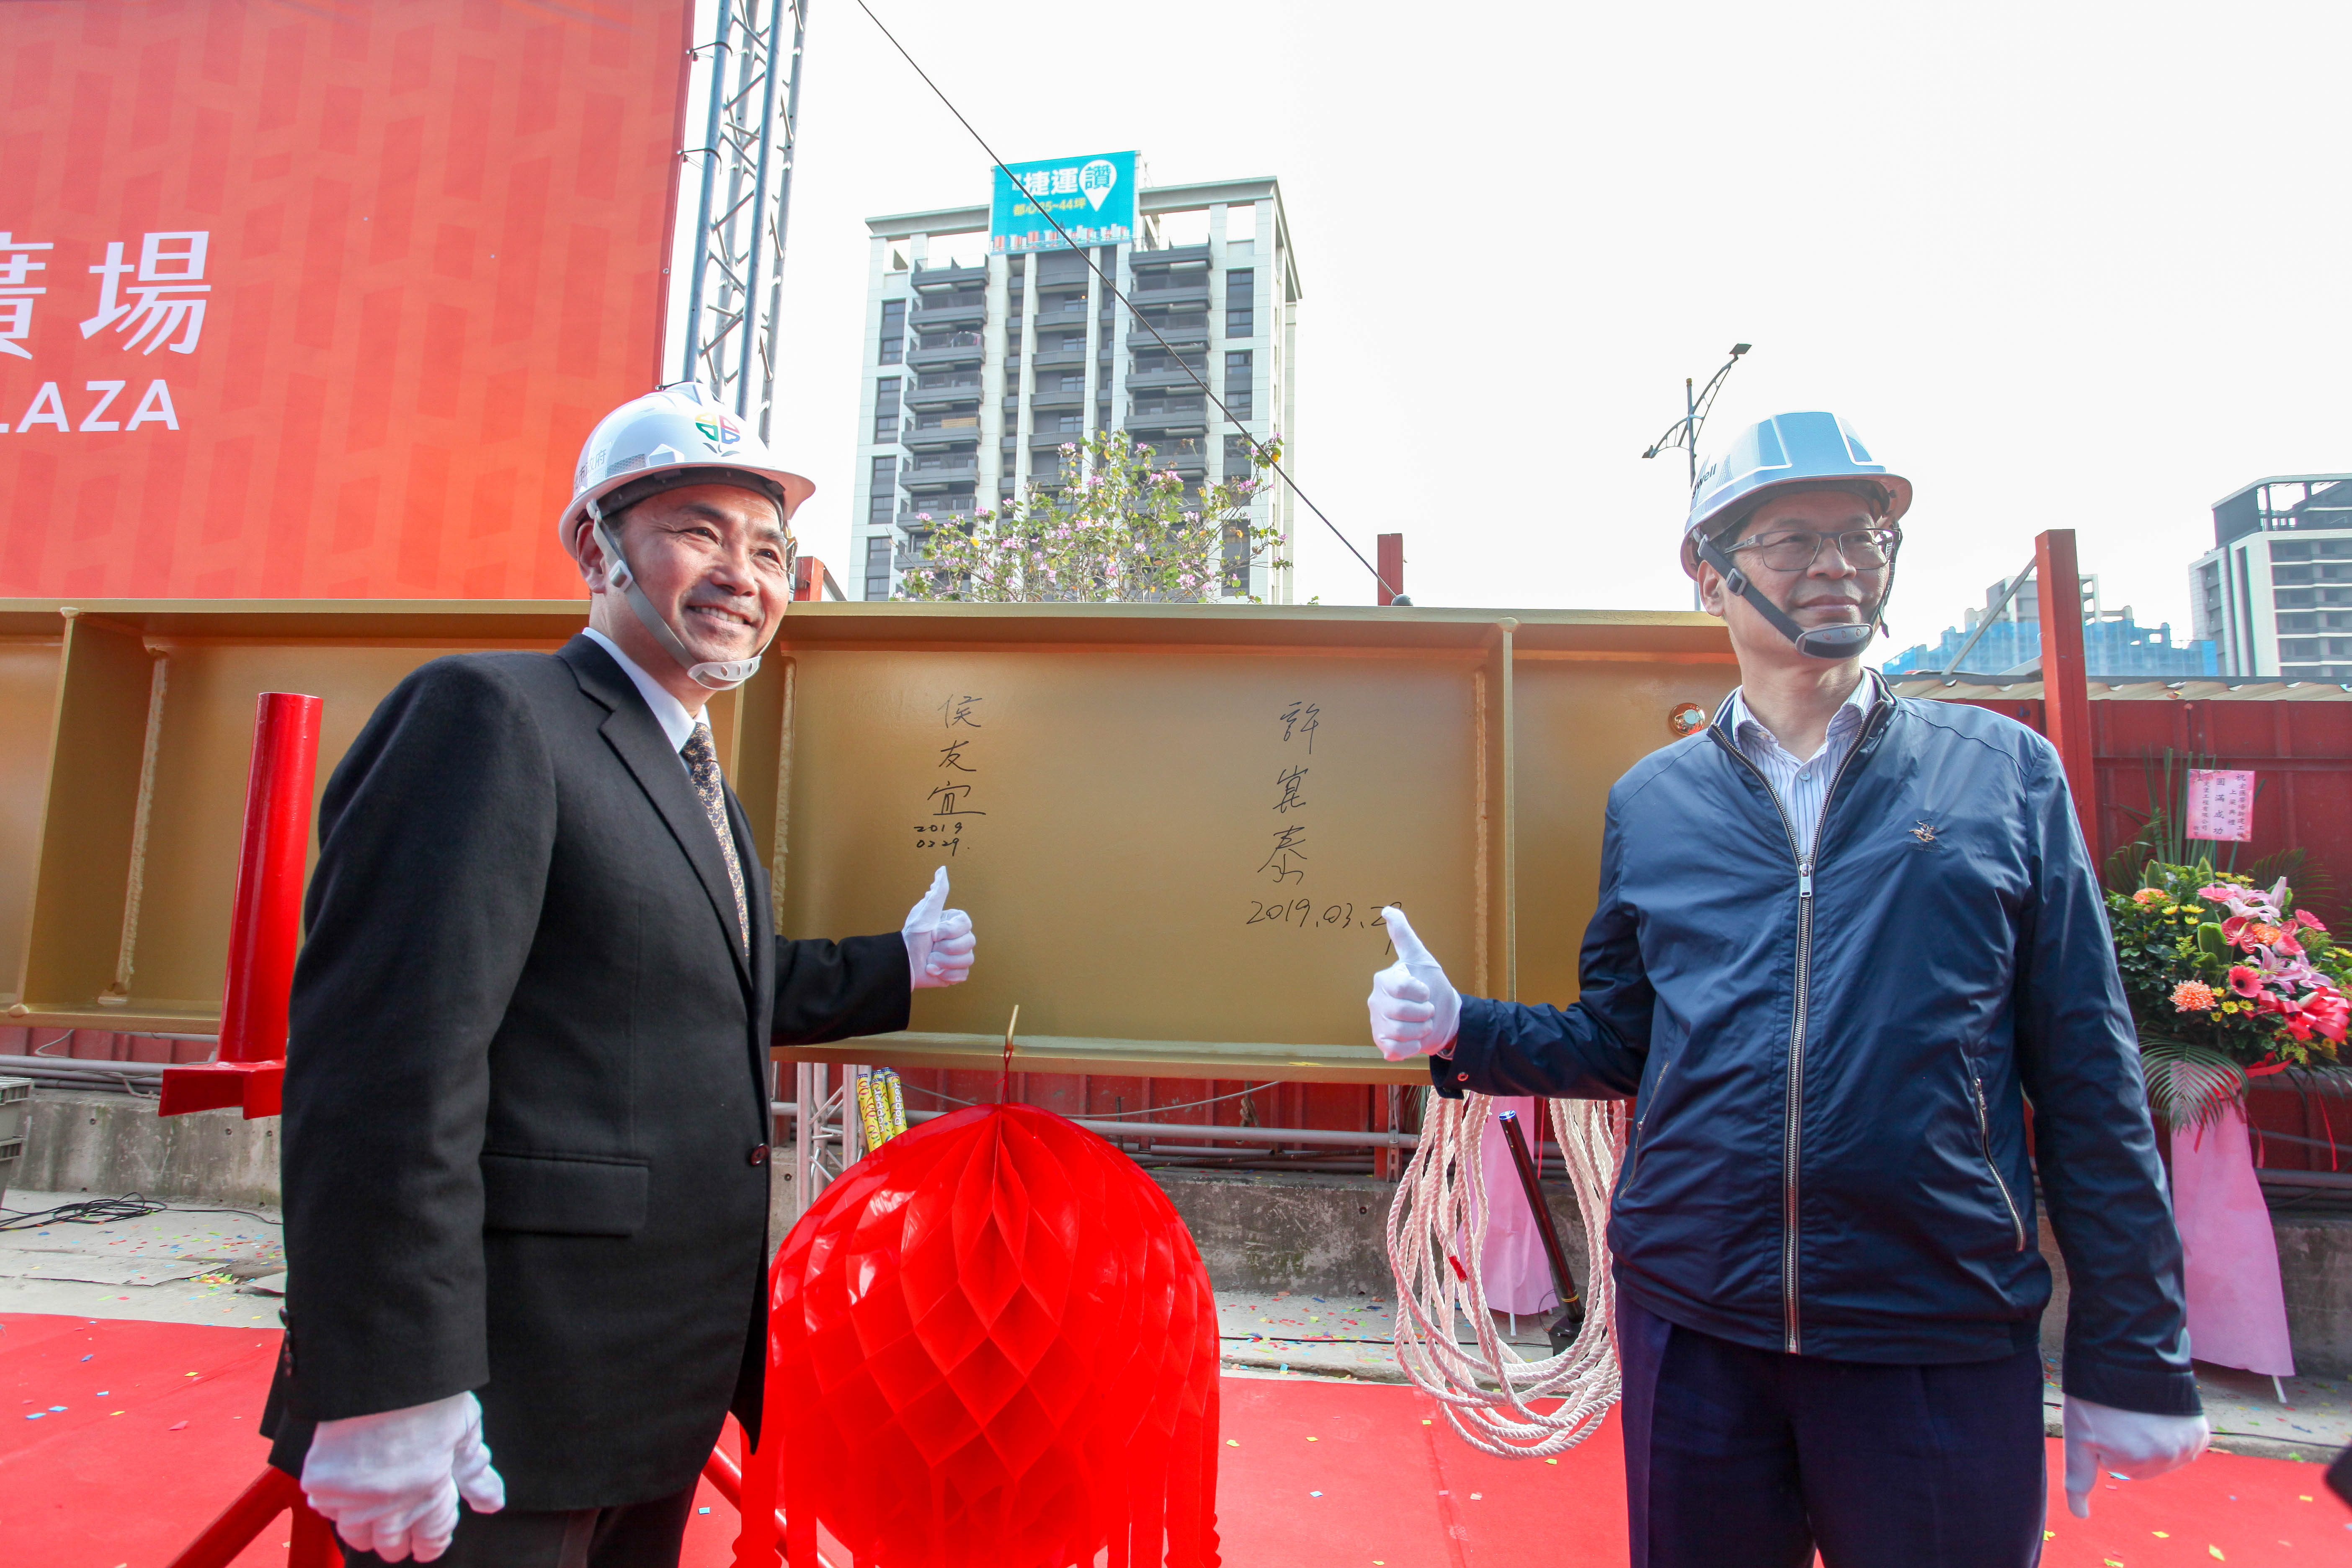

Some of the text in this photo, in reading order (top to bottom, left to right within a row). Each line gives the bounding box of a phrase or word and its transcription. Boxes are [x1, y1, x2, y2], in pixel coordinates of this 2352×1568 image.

[0, 379, 180, 433] AZA
[927, 694, 986, 815] 侯友宜
[913, 822, 963, 834] 2019
[2213, 778, 2226, 835] 圓滿成功
[874, 1089, 885, 1132] popper
[893, 1082, 903, 1126] popper
